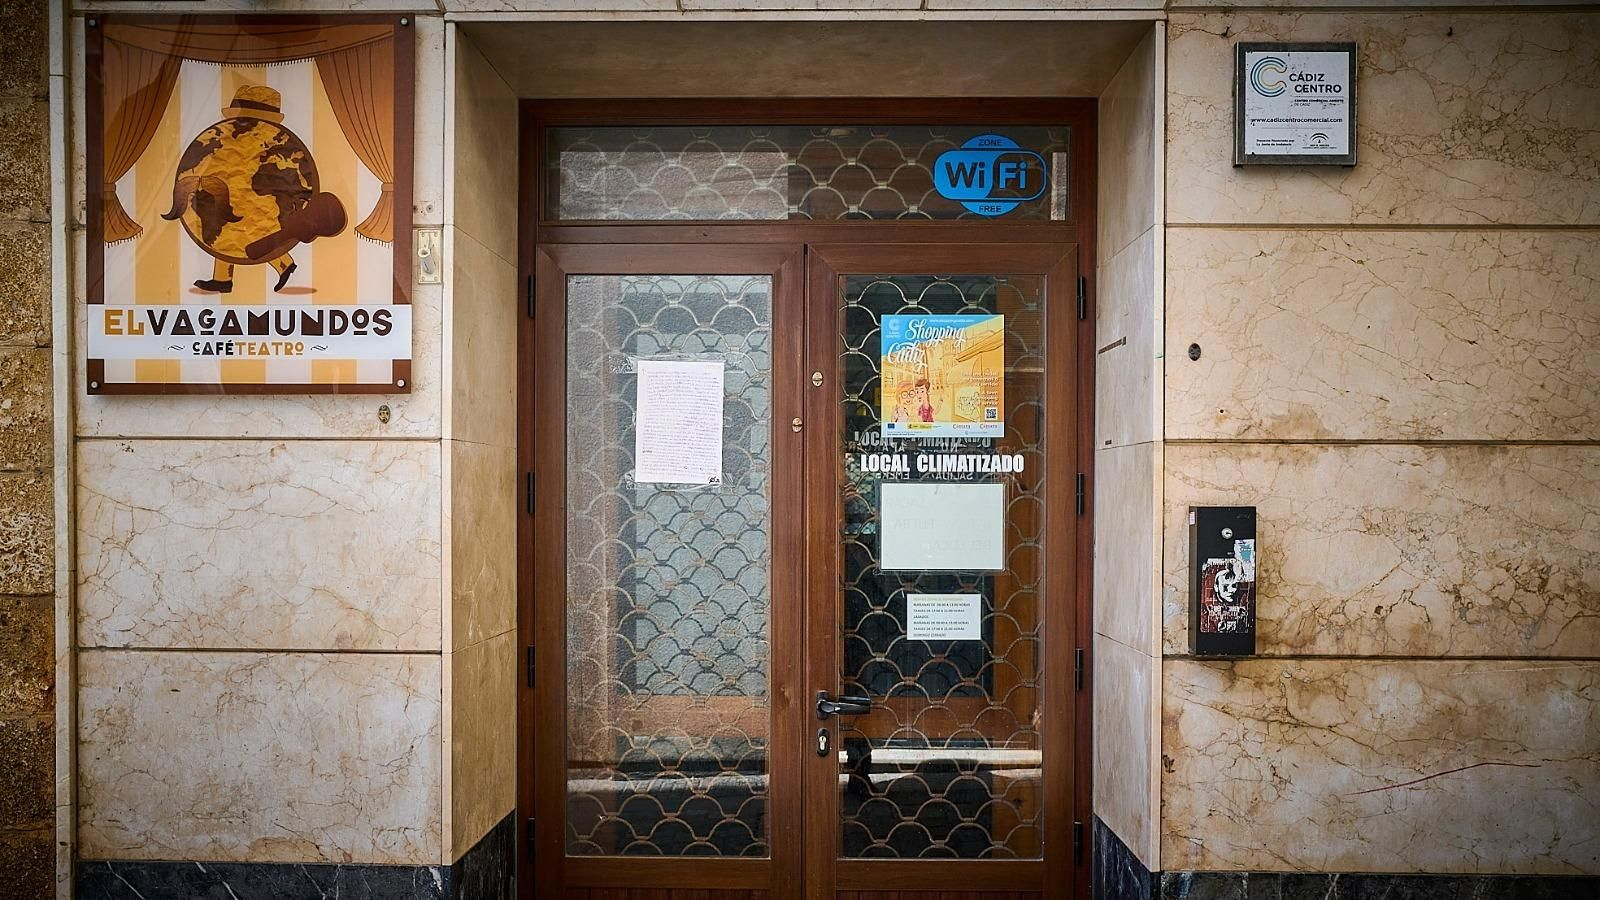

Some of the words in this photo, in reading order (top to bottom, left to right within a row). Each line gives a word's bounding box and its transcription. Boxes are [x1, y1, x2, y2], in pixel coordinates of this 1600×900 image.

[1289, 71, 1325, 82] CÁDIZ
[1294, 84, 1342, 94] CENTRO
[905, 318, 966, 348] Shopping
[860, 454, 910, 472] LOCAL
[916, 454, 1024, 472] CLIMATIZADO
